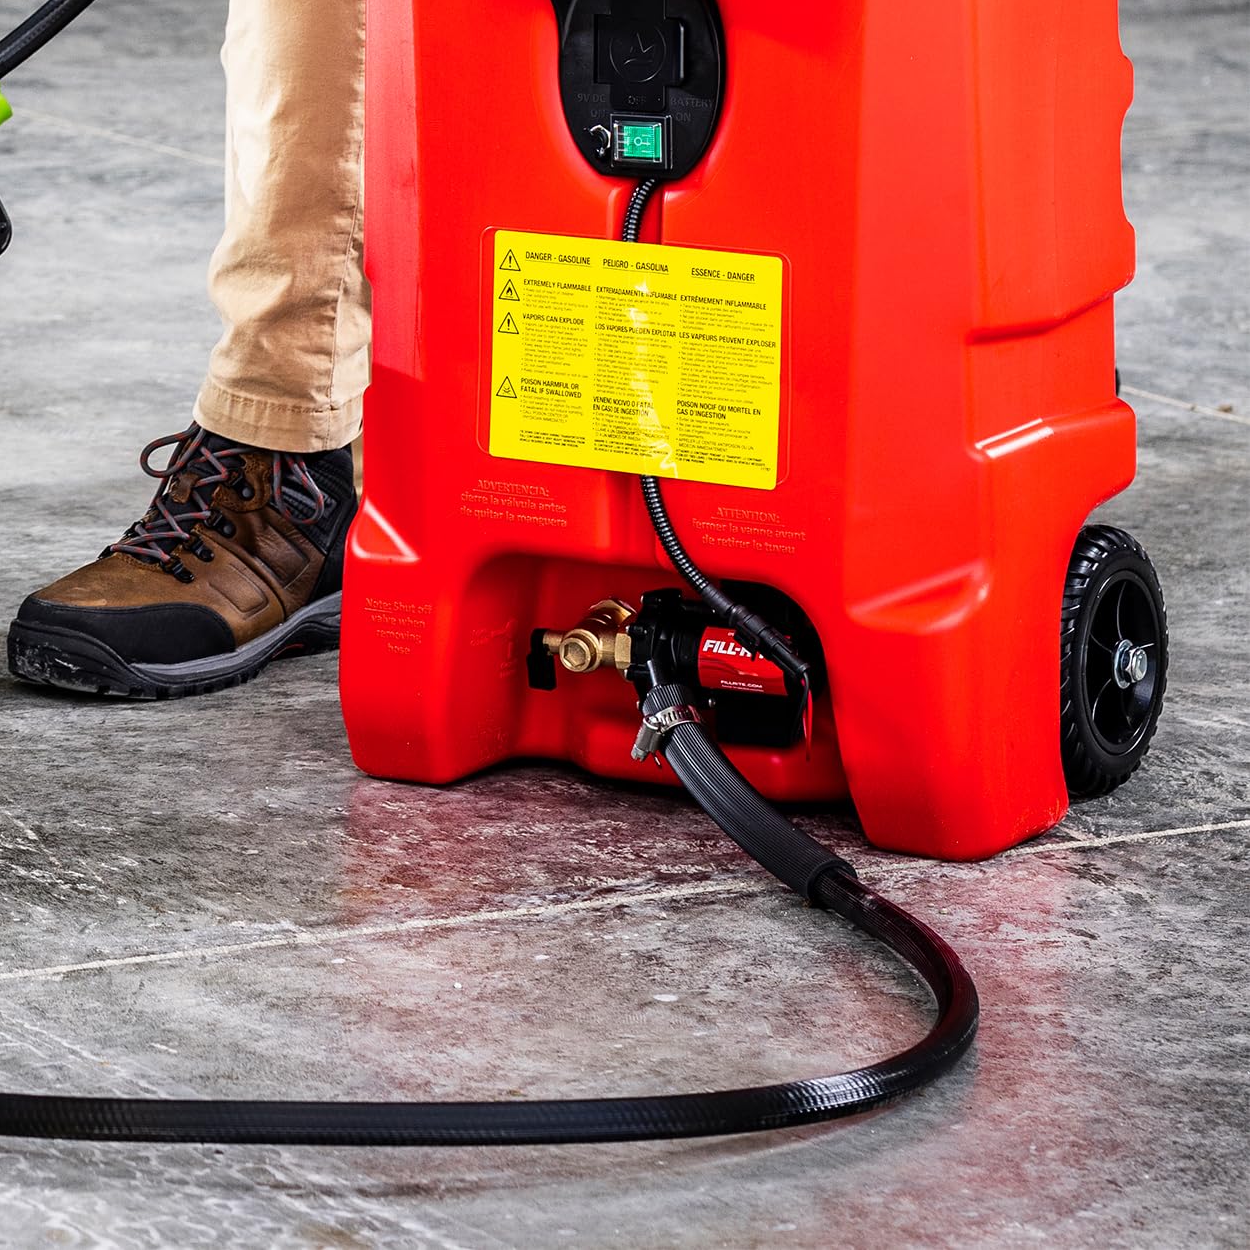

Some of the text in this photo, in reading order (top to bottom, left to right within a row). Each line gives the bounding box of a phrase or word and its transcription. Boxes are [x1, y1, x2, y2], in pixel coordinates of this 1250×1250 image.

[577, 93, 590, 103] 9V
[671, 95, 714, 108] BATTERY
[676, 112, 692, 122] ON
[525, 251, 552, 261] DANGER
[558, 254, 590, 265] GASOLINE
[603, 258, 628, 268] PELIGRO
[635, 262, 669, 272] GASOLINA
[691, 268, 720, 278] ESSENCE
[727, 271, 755, 282] DANGER
[523, 279, 591, 292] EXTREMELY FLAMMABLE
[724, 299, 767, 310] INFLAMMABLE
[522, 313, 545, 321] VAPORS
[559, 317, 584, 325] EXPLODE
[606, 325, 628, 333] VAPORES
[629, 326, 650, 334] PUEDEN
[651, 328, 676, 338] EXPLOTAR
[690, 333, 718, 342] VAPEURS
[719, 335, 744, 344] PEUVENT
[746, 338, 776, 348] EXPLOSER
[521, 378, 541, 386] POISON
[546, 388, 581, 398] SWALLOWED
[676, 400, 698, 409] POISON
[700, 402, 716, 411] NOCIF
[718, 404, 727, 412] OU
[728, 405, 751, 414] MORTEL
[676, 408, 689, 416] CAS
[477, 479, 550, 496] ADVERTENCIA:
[461, 491, 488, 504] cierre
[490, 495, 499, 505] la
[539, 502, 566, 513] antes
[461, 506, 567, 527] de quitar la manguera
[717, 506, 780, 523] ATTENTION:
[692, 517, 726, 531] Fermer
[729, 523, 738, 533] la
[775, 530, 806, 540] avant
[702, 534, 715, 545] de
[717, 537, 750, 548] retirer
[753, 539, 762, 550] le
[365, 598, 433, 614] Note: Shut off
[371, 613, 426, 628] valve when
[376, 629, 422, 644] removing
[387, 643, 410, 654] hose
[720, 680, 763, 688] FILLRITE.COM
